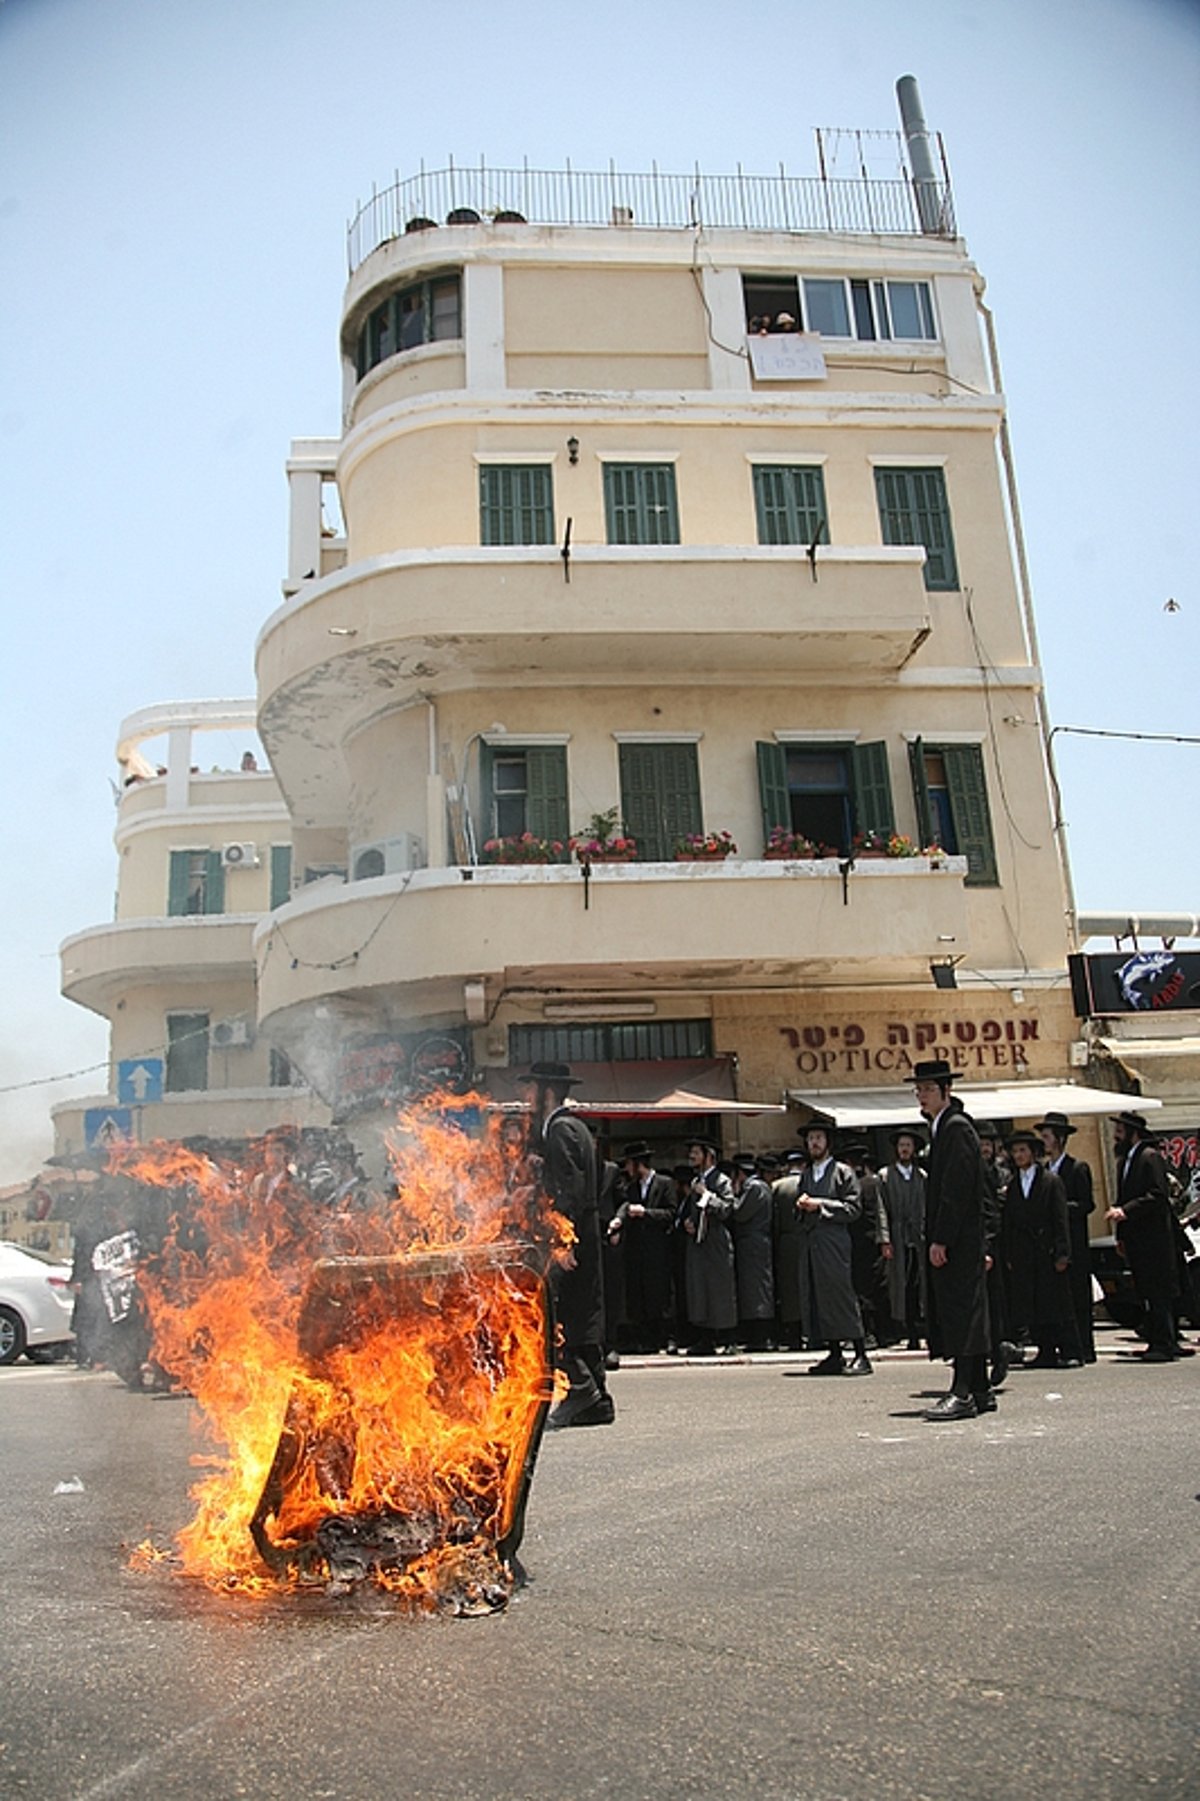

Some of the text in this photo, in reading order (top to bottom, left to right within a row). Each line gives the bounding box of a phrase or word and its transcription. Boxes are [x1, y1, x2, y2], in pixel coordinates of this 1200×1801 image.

[780, 1019, 1040, 1051] אופטיקה פיטר
[796, 1044, 1030, 1074] OPTICA PETER
